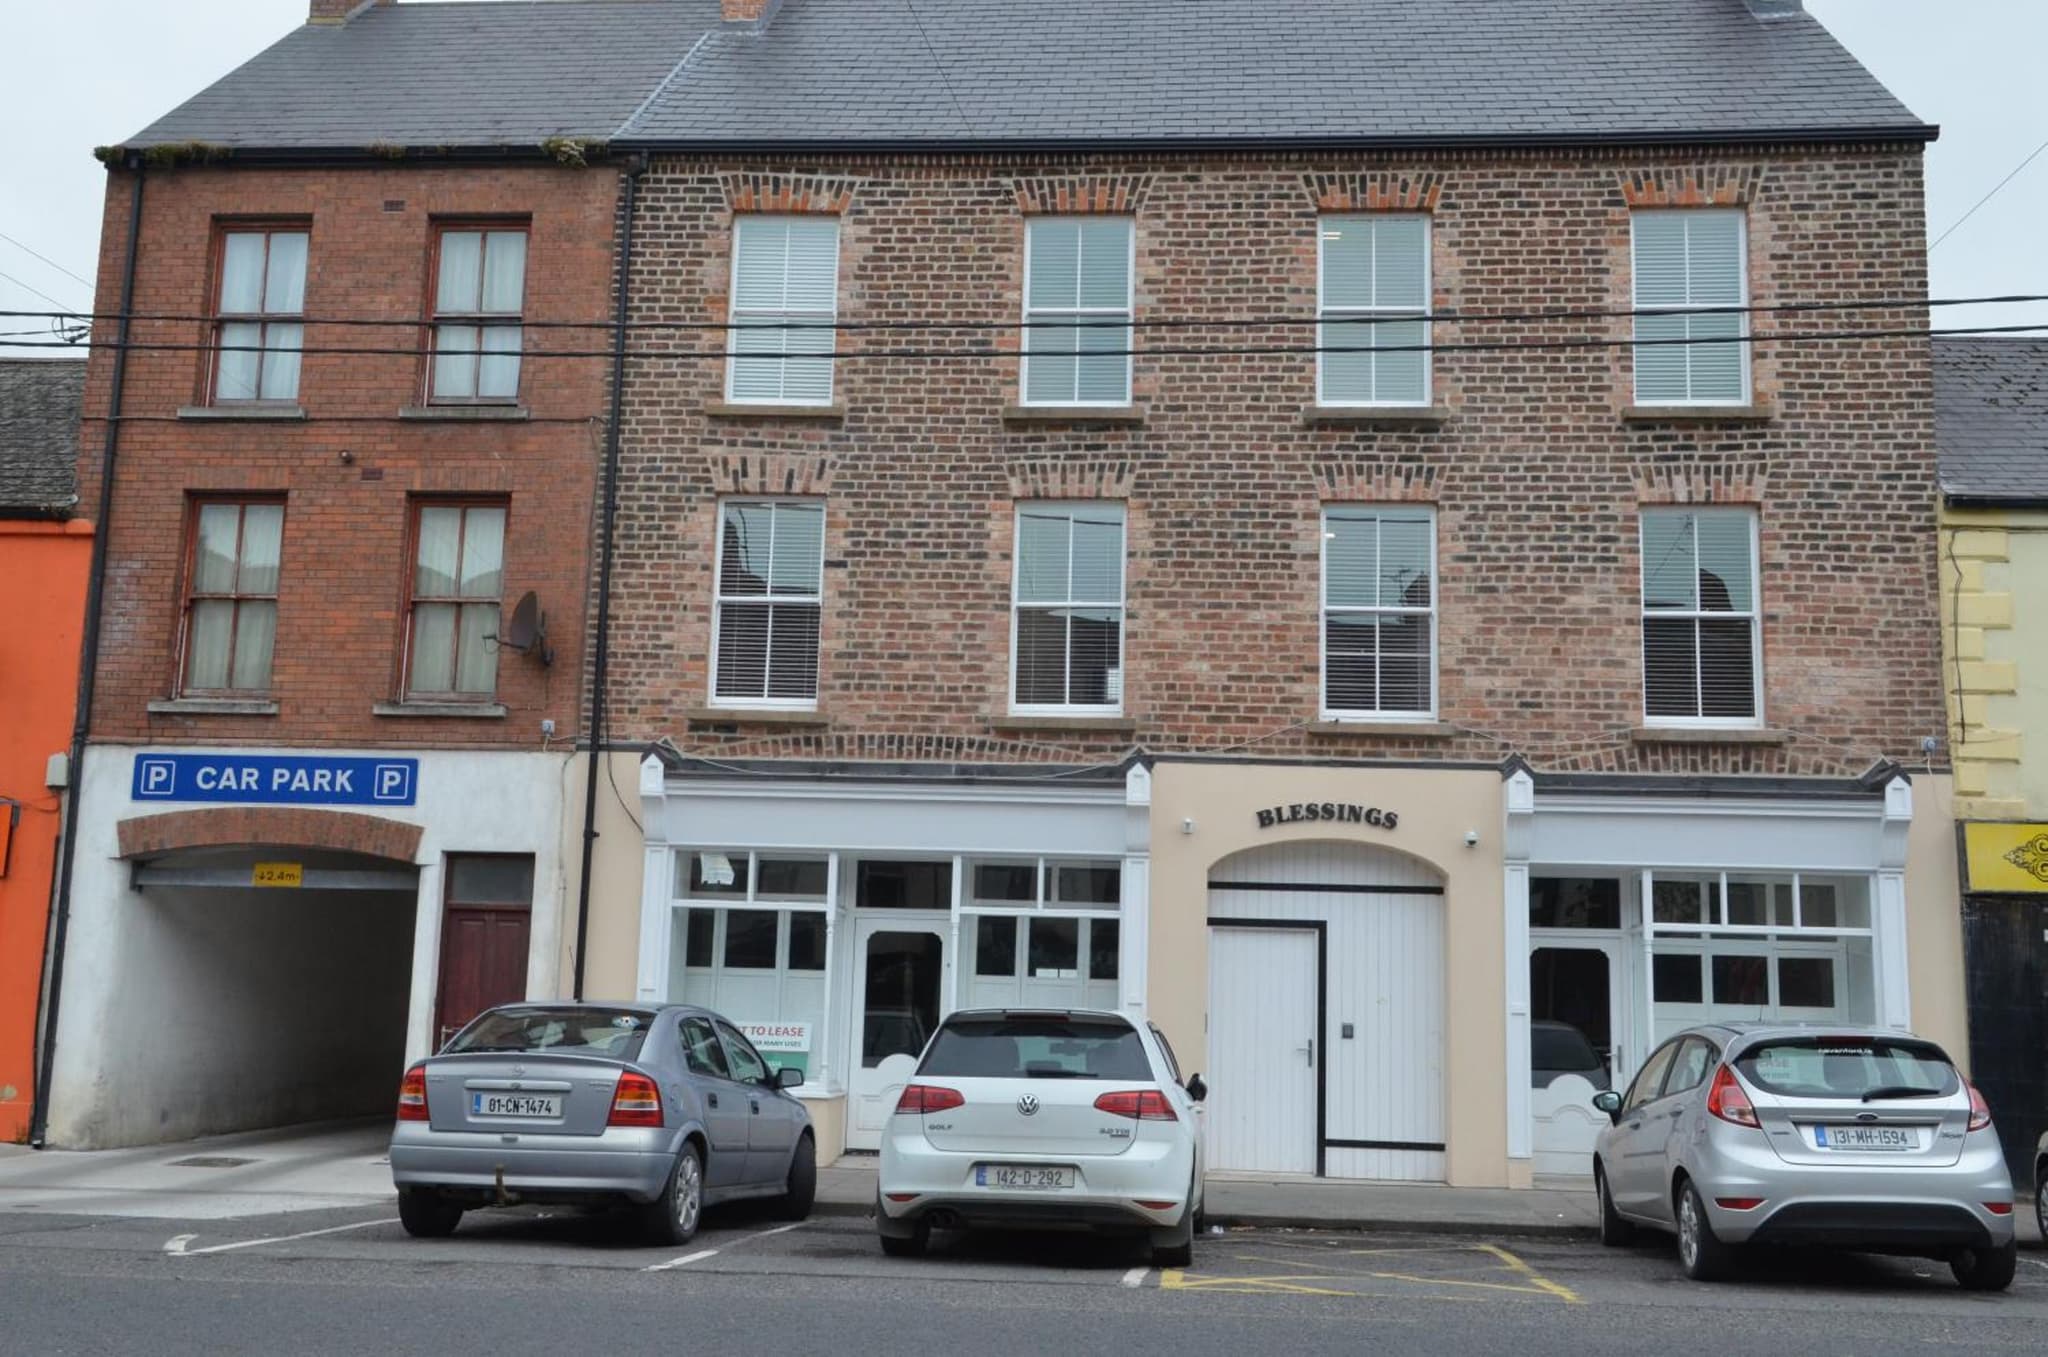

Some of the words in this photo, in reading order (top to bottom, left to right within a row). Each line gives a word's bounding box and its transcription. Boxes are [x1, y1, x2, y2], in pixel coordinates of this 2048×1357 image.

[196, 767, 259, 791] CAR
[271, 768, 354, 793] PARK
[1256, 803, 1398, 830] BLESSINGS
[768, 1026, 805, 1038] LEASE
[1833, 1130, 1908, 1144] 131-MH-1594
[996, 1170, 1062, 1186] 142-D-292
